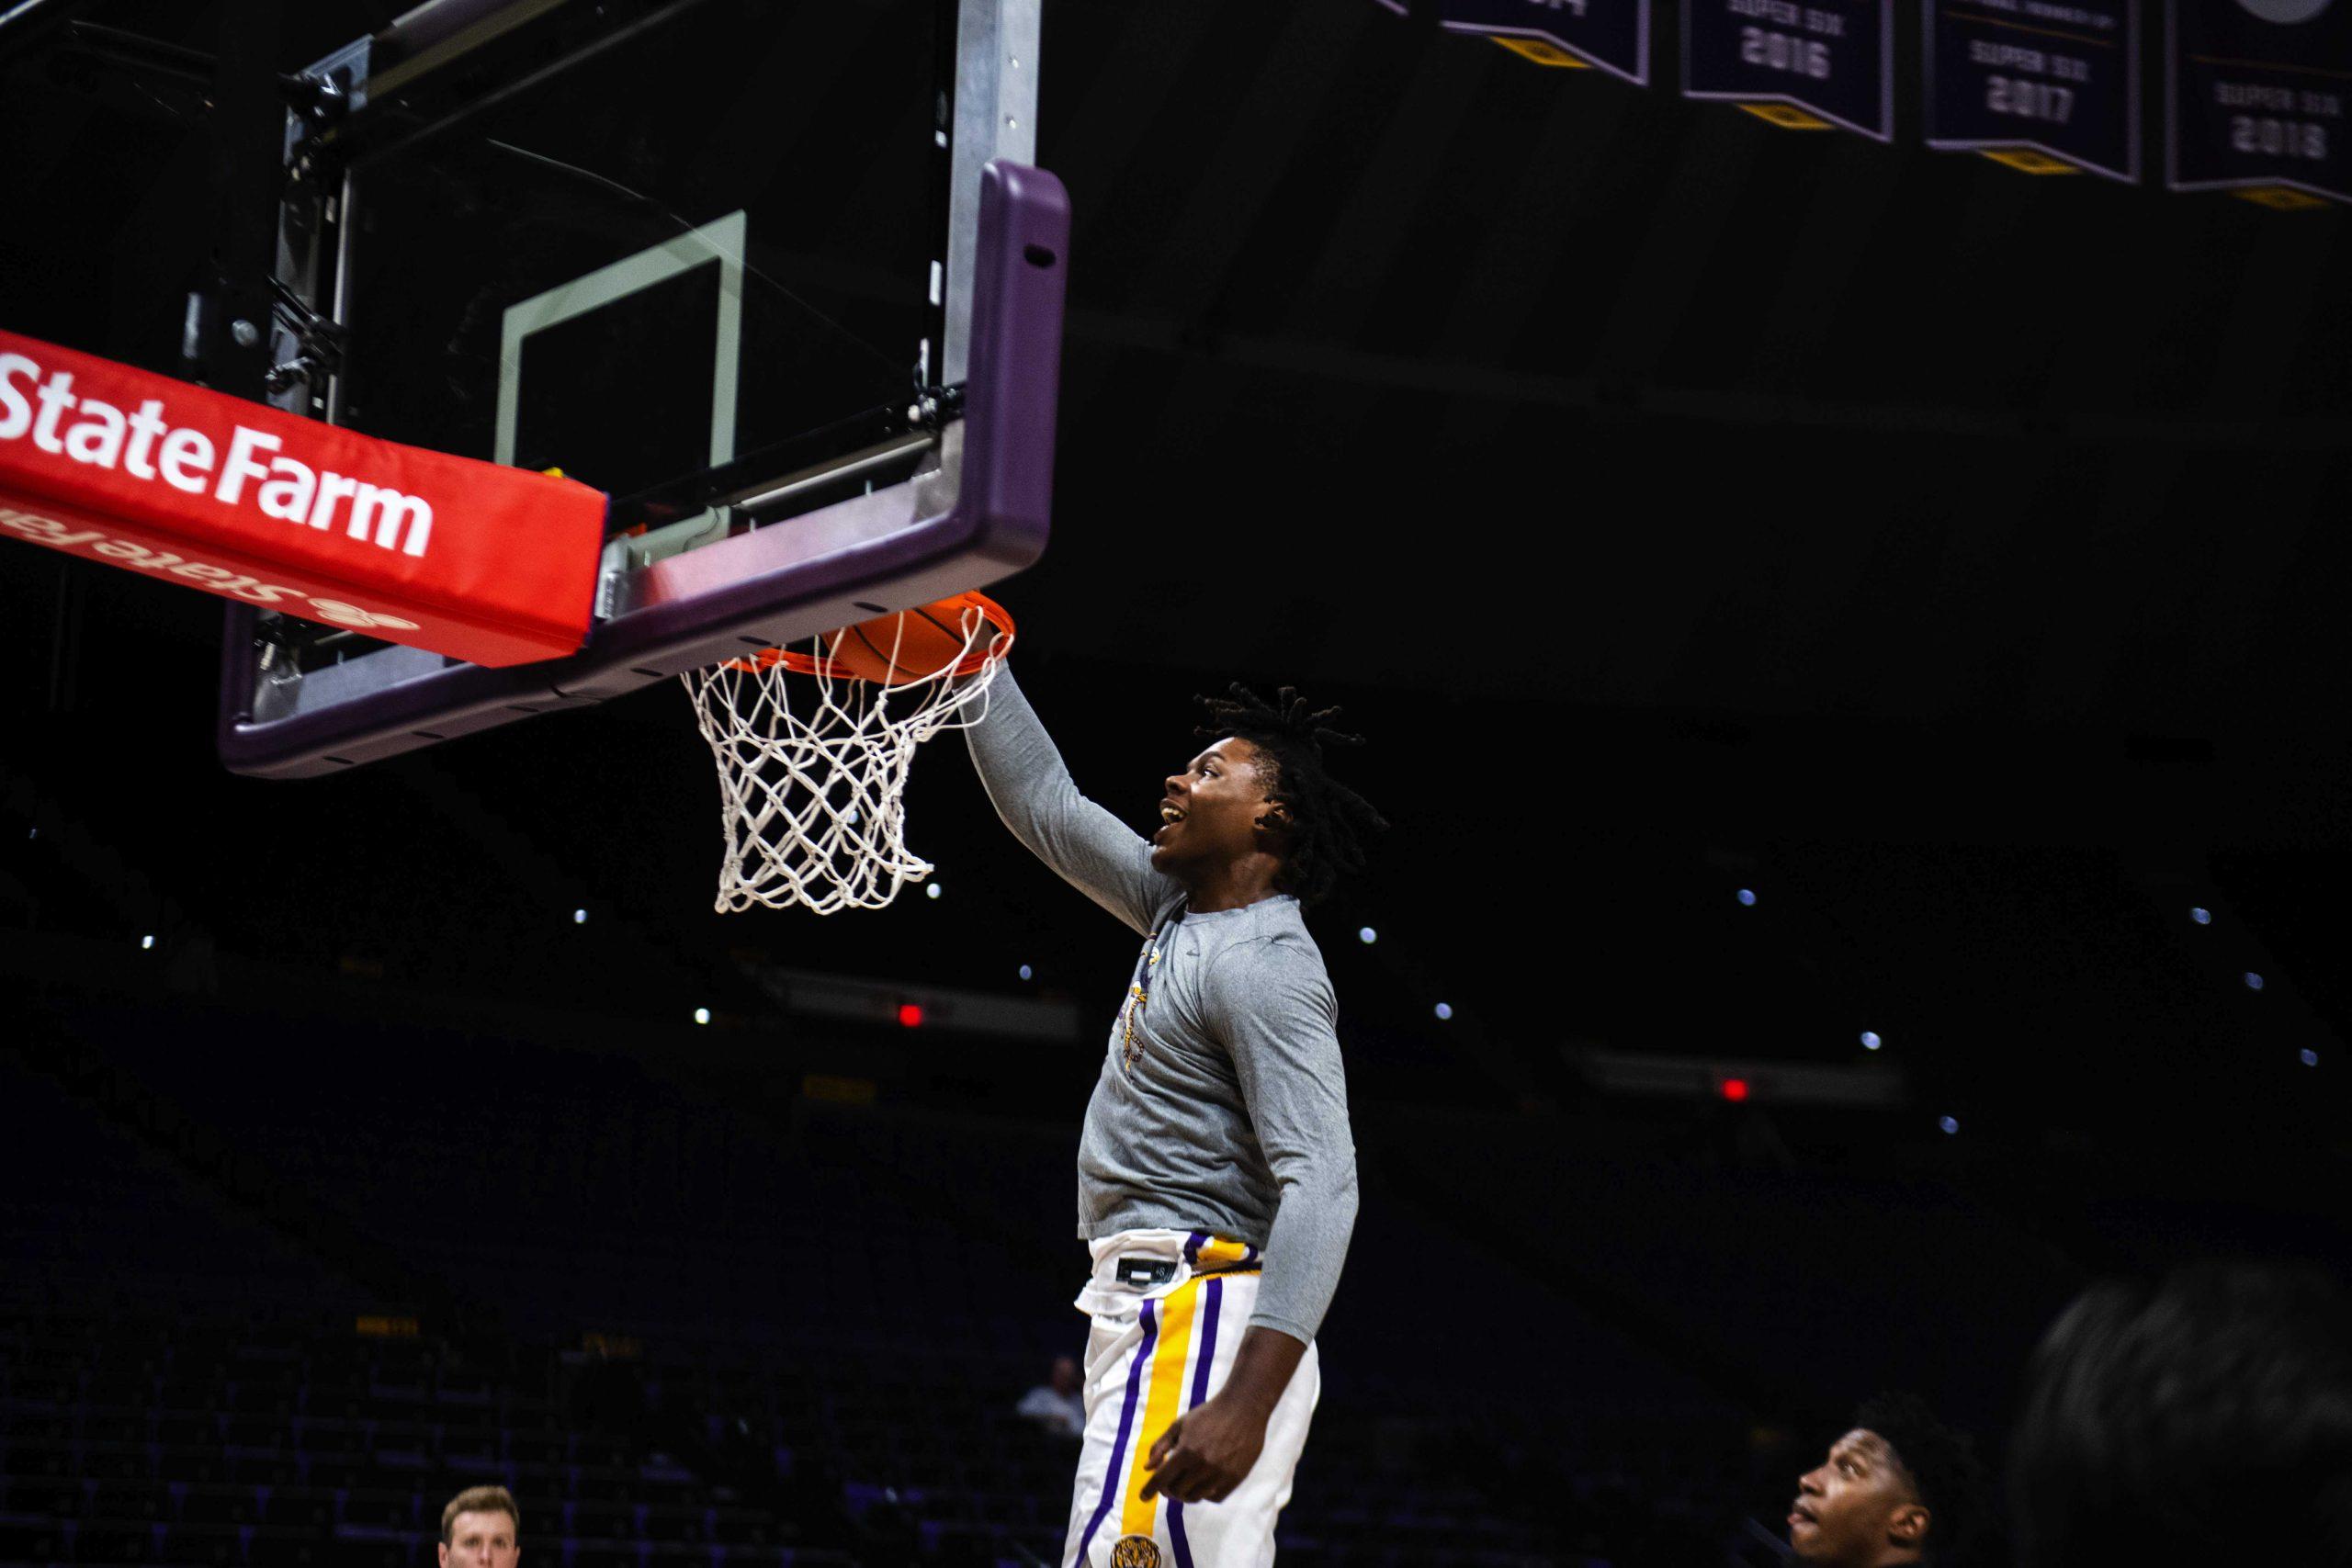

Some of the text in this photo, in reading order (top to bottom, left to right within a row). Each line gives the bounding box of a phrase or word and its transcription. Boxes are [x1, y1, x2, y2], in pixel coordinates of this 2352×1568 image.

[1740, 25, 1830, 80] 2016
[1968, 39, 2092, 84] SUPER SIX
[1984, 73, 2075, 125] 2017
[2212, 80, 2295, 111] SUPER
[2230, 114, 2328, 161] 2018
